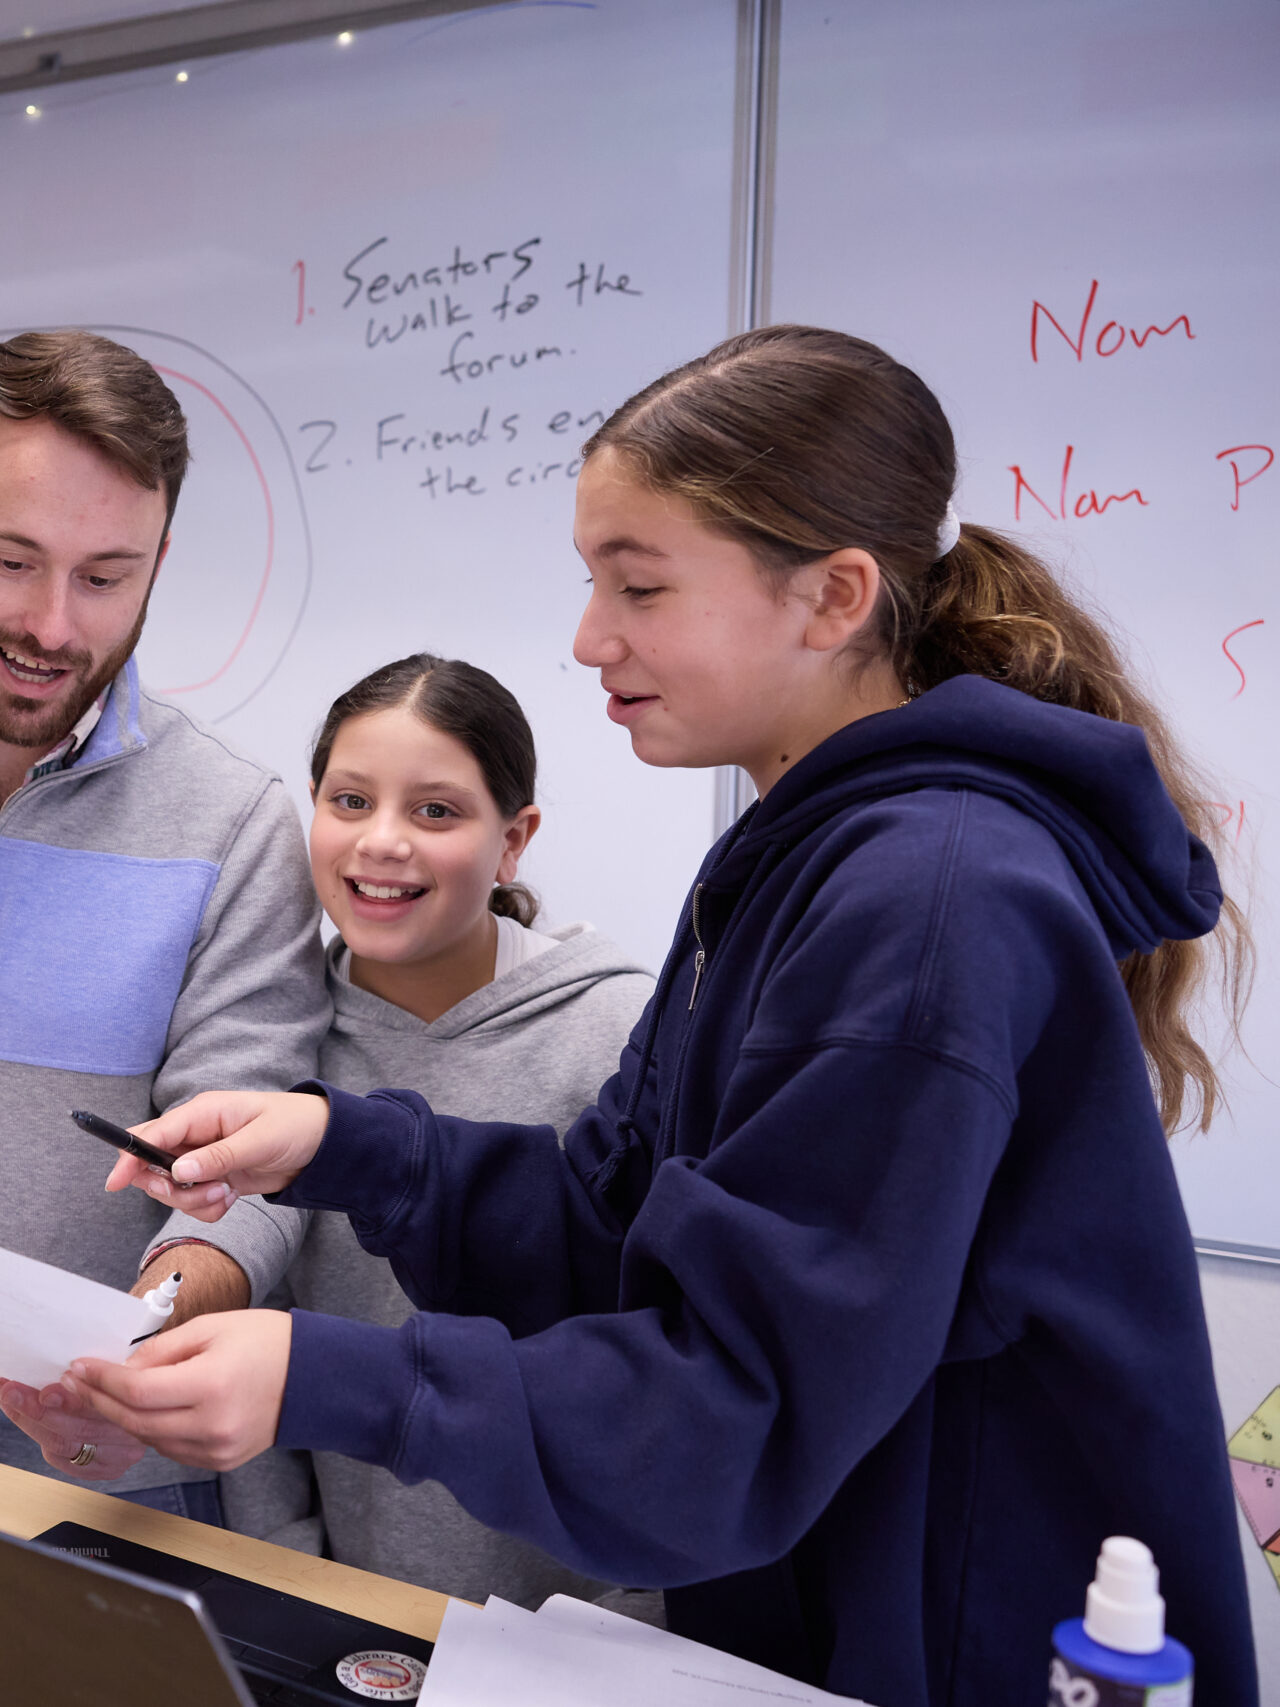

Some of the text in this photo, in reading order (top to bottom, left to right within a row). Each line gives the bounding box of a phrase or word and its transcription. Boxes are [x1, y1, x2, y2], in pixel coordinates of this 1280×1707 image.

[340, 237, 542, 310] Senators
[492, 283, 541, 322] to
[565, 261, 644, 307] the
[1030, 278, 1197, 364] Nom
[548, 409, 606, 434] en
[420, 457, 583, 500] the circ
